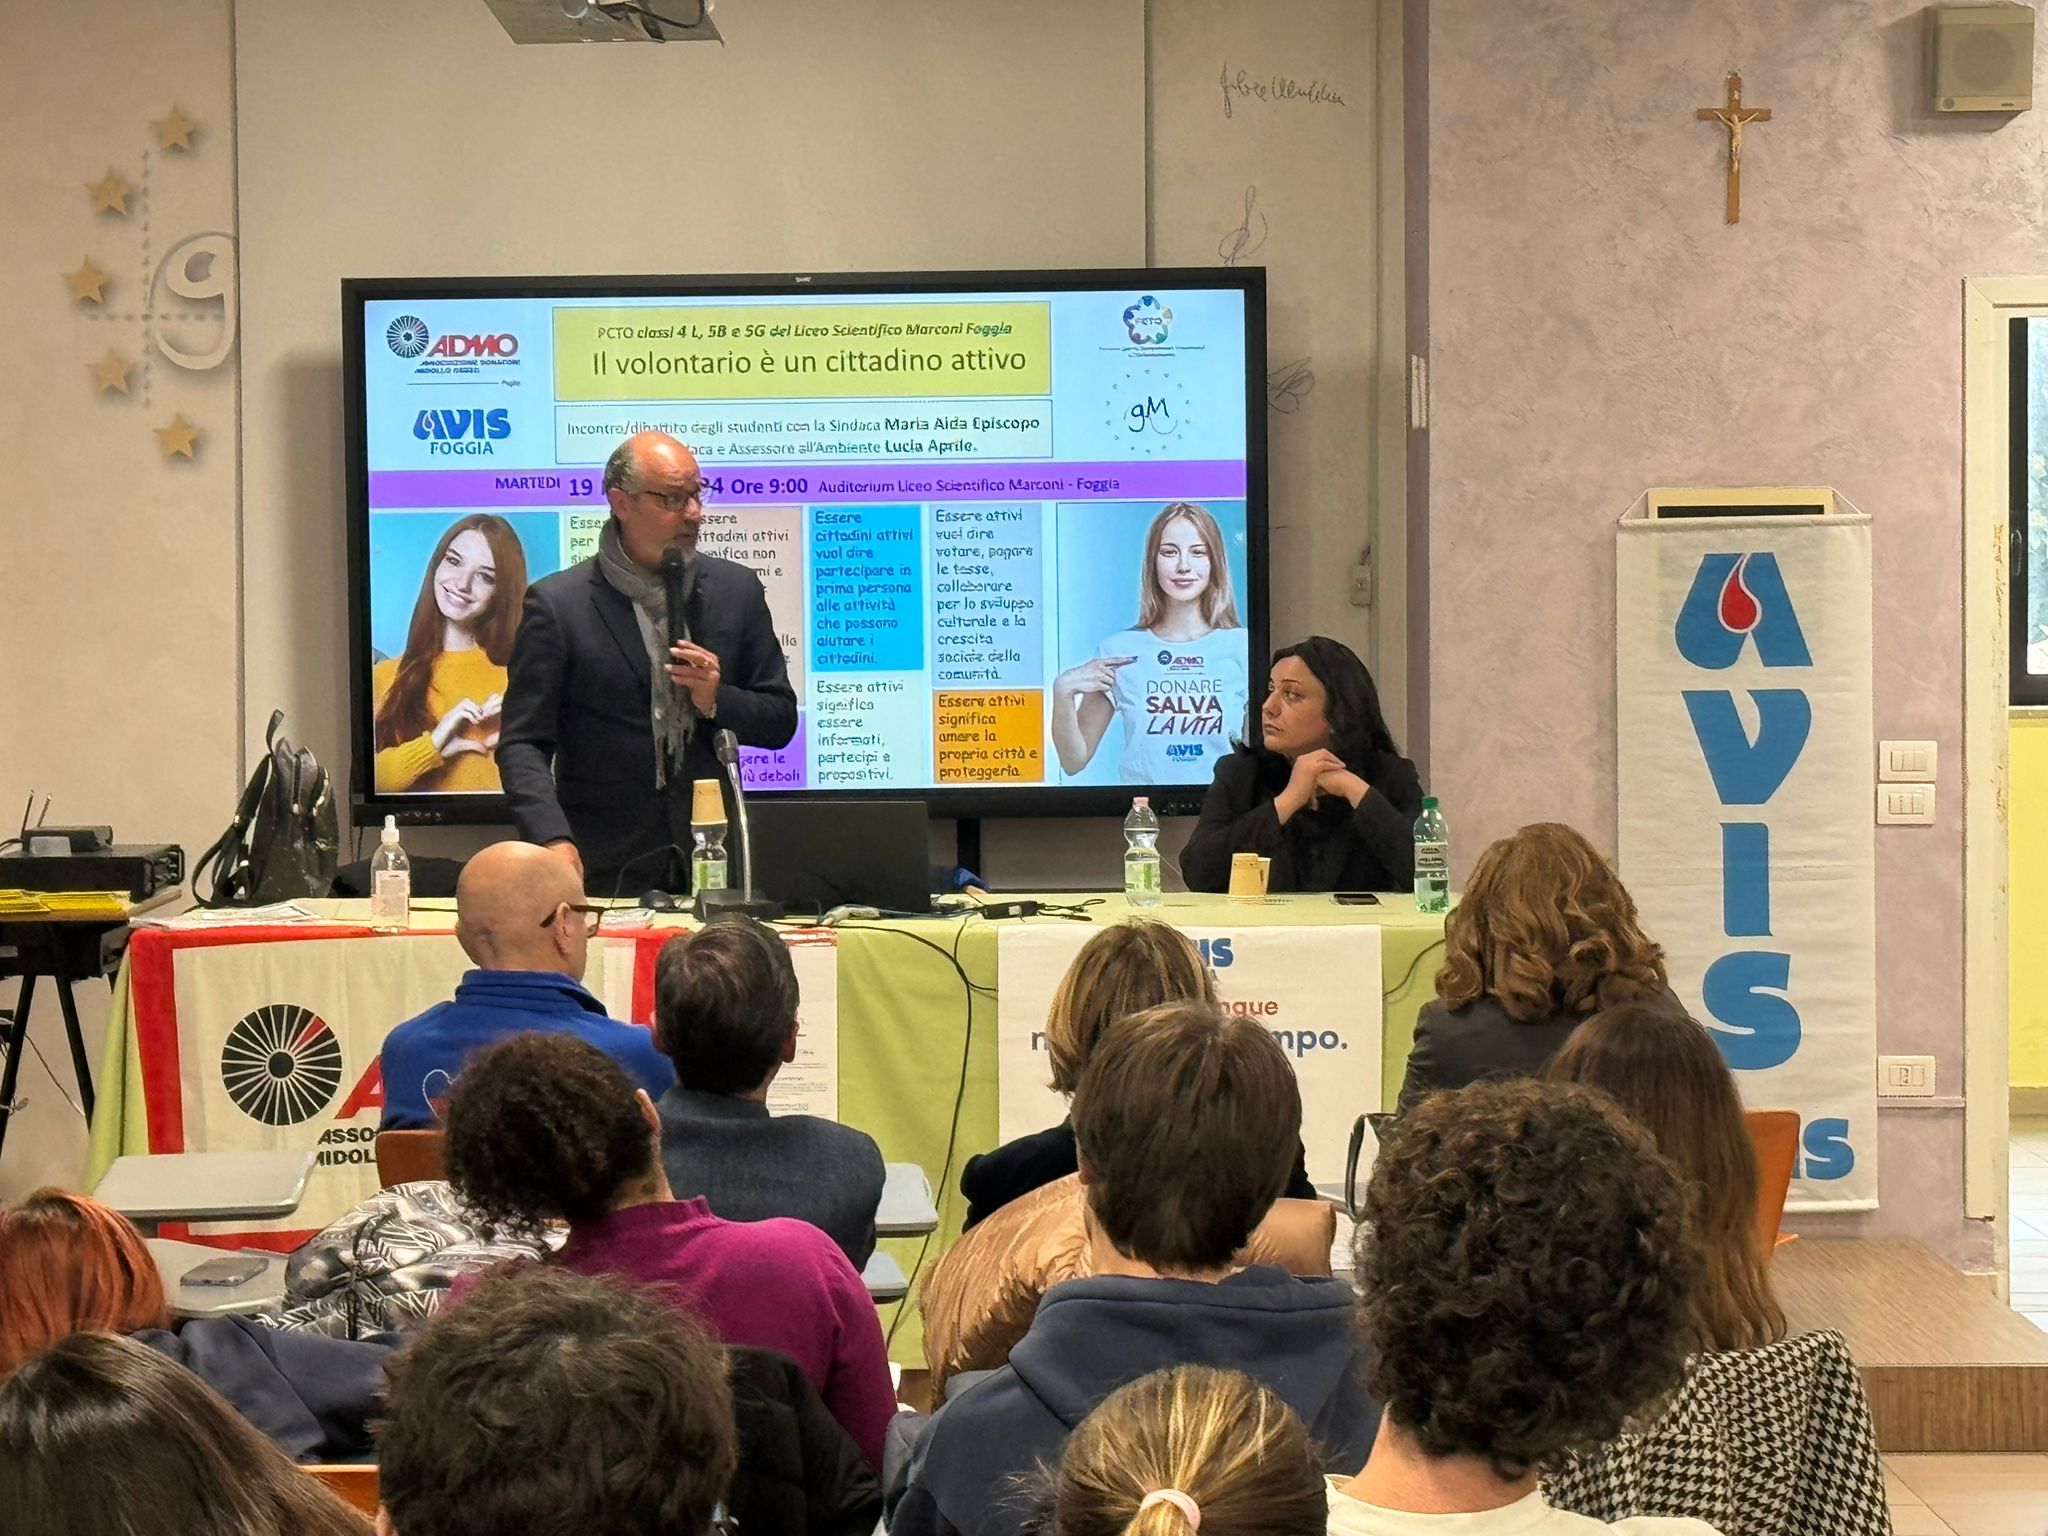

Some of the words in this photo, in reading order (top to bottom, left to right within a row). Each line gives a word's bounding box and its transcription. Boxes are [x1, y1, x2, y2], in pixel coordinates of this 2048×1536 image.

[597, 326, 634, 339] PCTO
[637, 325, 674, 339] classi
[677, 325, 687, 338] 4
[707, 325, 727, 338] 5B
[731, 328, 741, 338] e
[744, 324, 766, 337] 5G
[769, 325, 791, 337] del
[794, 324, 829, 337] Liceo
[832, 323, 902, 338] Scientifico
[906, 323, 963, 335] Marconi
[966, 322, 1012, 337] Foggia
[426, 333, 519, 358] ADMO
[593, 351, 607, 375] Il
[616, 350, 751, 375] volontario
[760, 348, 775, 373] è
[785, 354, 816, 373] un
[826, 347, 942, 372] cittadino
[951, 347, 1026, 371] attivo
[413, 408, 511, 440] AVIS
[691, 420, 723, 435] degli
[727, 420, 783, 434] studenti
[786, 422, 810, 433] con
[814, 419, 825, 432] la
[830, 419, 881, 432] Sindaca
[885, 418, 929, 431] Maria
[933, 417, 967, 430] Aida
[973, 417, 1040, 432] Episcopo
[430, 441, 494, 455] FOGGIA
[717, 446, 726, 456] e
[729, 443, 795, 456] Assessore
[885, 439, 923, 453] Lucia
[928, 439, 978, 455] Aprile.
[570, 478, 593, 496] 19
[731, 479, 763, 494] Ore
[769, 478, 808, 494] 9:00
[818, 479, 894, 493] Auditorium
[898, 479, 932, 492] Liceo
[936, 478, 1004, 492] Scientifico
[1009, 478, 1063, 490] Marconi
[1077, 477, 1120, 492] Foggia
[700, 514, 738, 525] ssere
[815, 510, 862, 524] Essere
[936, 509, 982, 523] Essere
[986, 508, 1023, 523] attivi
[699, 529, 747, 543] ittadini
[752, 529, 790, 542] attivi
[815, 528, 872, 542] cittadini
[877, 528, 914, 541] attivi
[936, 528, 962, 541] vuol
[966, 528, 994, 540] dire
[570, 537, 594, 550] per
[752, 548, 776, 560] non
[816, 546, 842, 559] vuol
[847, 545, 873, 559] dire
[988, 547, 1033, 560] pagare
[815, 563, 894, 580] partecipare
[899, 563, 911, 576] in
[937, 562, 949, 575] le
[816, 581, 854, 597] prima
[858, 583, 912, 597] persona
[937, 580, 1012, 592] collaborare
[816, 598, 841, 612] alle
[937, 599, 960, 613] per
[964, 597, 976, 610] lo
[816, 616, 842, 630] che
[845, 618, 898, 632] possono
[937, 615, 997, 628] culturale
[1001, 617, 1010, 628] e
[1014, 614, 1026, 627] la
[816, 633, 865, 647] aiutare
[937, 632, 993, 646] crescita
[988, 649, 1021, 663] della
[817, 680, 863, 694] Essere
[867, 679, 904, 693] attivi
[1146, 679, 1222, 695] DONARE
[817, 699, 875, 714] significa
[938, 694, 985, 708] Essere
[988, 693, 1026, 707] attivi
[1145, 695, 1223, 714] SALVA
[817, 717, 863, 729] essere
[938, 712, 996, 728] significa
[1146, 715, 1175, 735] LA
[1180, 714, 1223, 735] VITA
[938, 730, 980, 743] amare
[984, 729, 997, 742] la
[773, 752, 785, 764] le
[882, 752, 891, 763] e
[939, 749, 991, 766] propria
[993, 746, 1026, 760] città
[1029, 748, 1038, 760] e
[759, 768, 800, 782] deboli
[317, 1126, 378, 1145] ASSO
